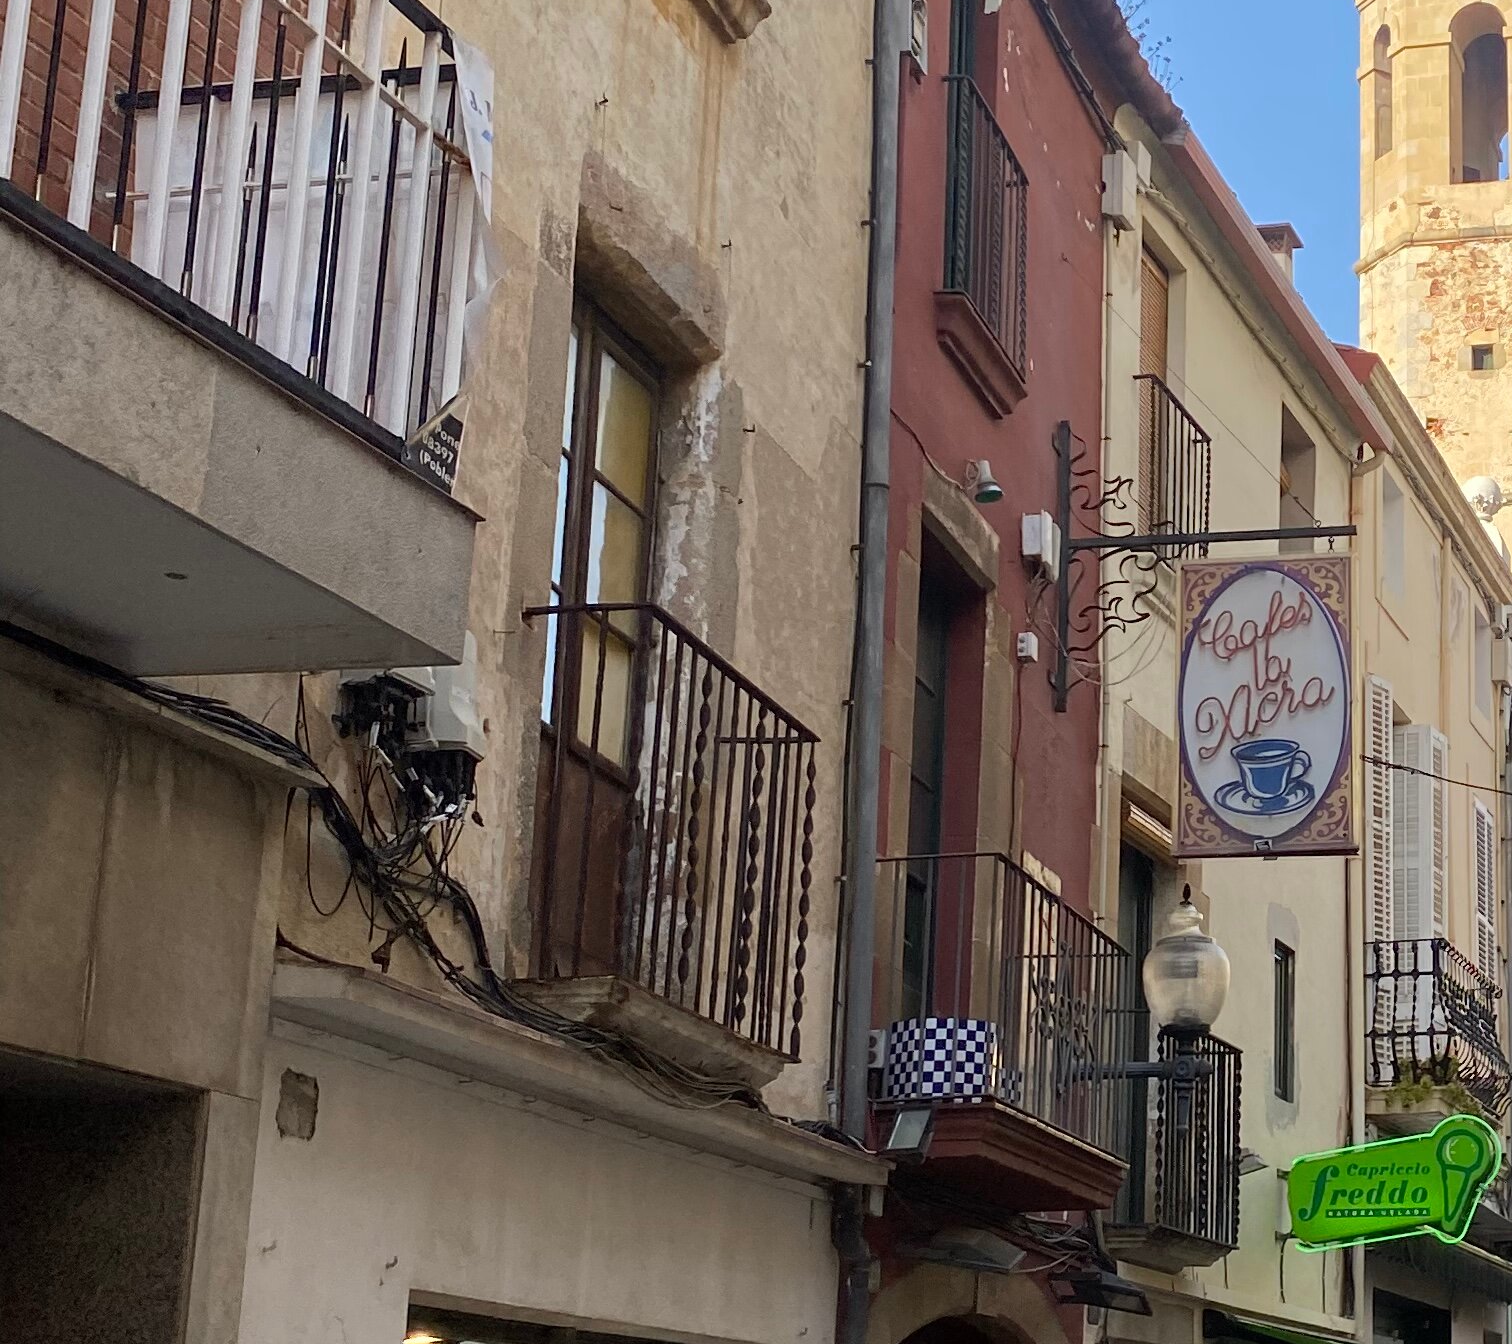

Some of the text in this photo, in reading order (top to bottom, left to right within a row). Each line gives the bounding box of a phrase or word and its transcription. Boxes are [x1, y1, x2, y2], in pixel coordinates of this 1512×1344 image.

[1252, 641, 1292, 691] la
[1298, 1164, 1429, 1222] freddo
[1346, 1161, 1431, 1179] Capriccio
